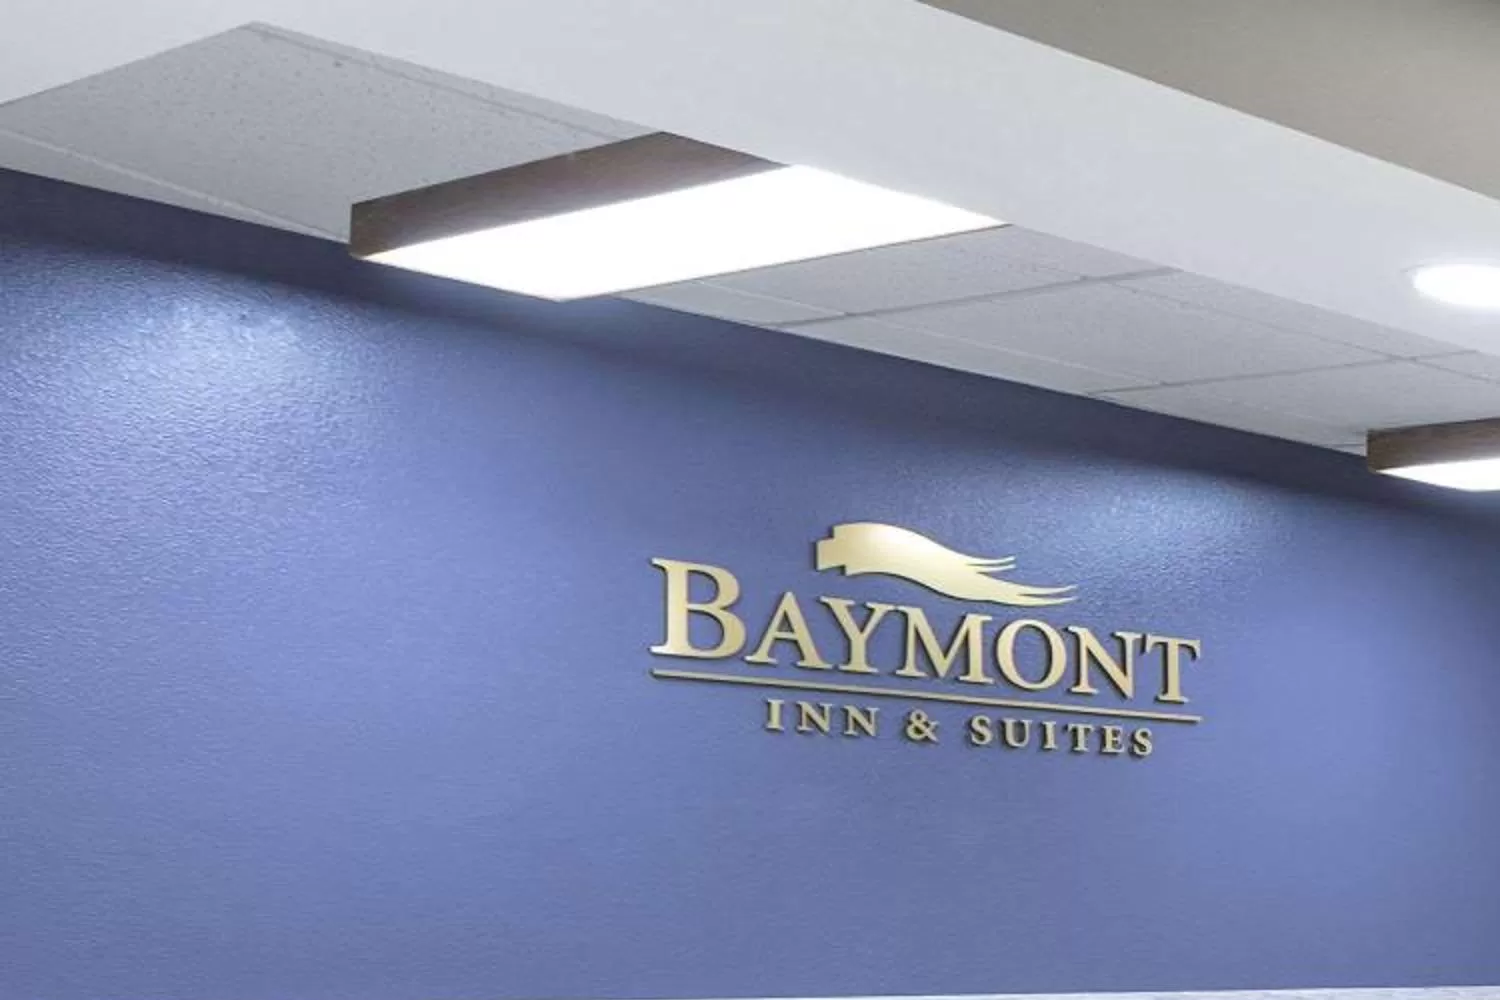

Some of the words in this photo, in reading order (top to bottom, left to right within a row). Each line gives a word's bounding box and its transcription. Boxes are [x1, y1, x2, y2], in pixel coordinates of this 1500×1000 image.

[649, 557, 1201, 703] BAYMONT
[766, 698, 878, 738] INN
[906, 710, 939, 742] &
[970, 715, 1154, 756] SUITES
